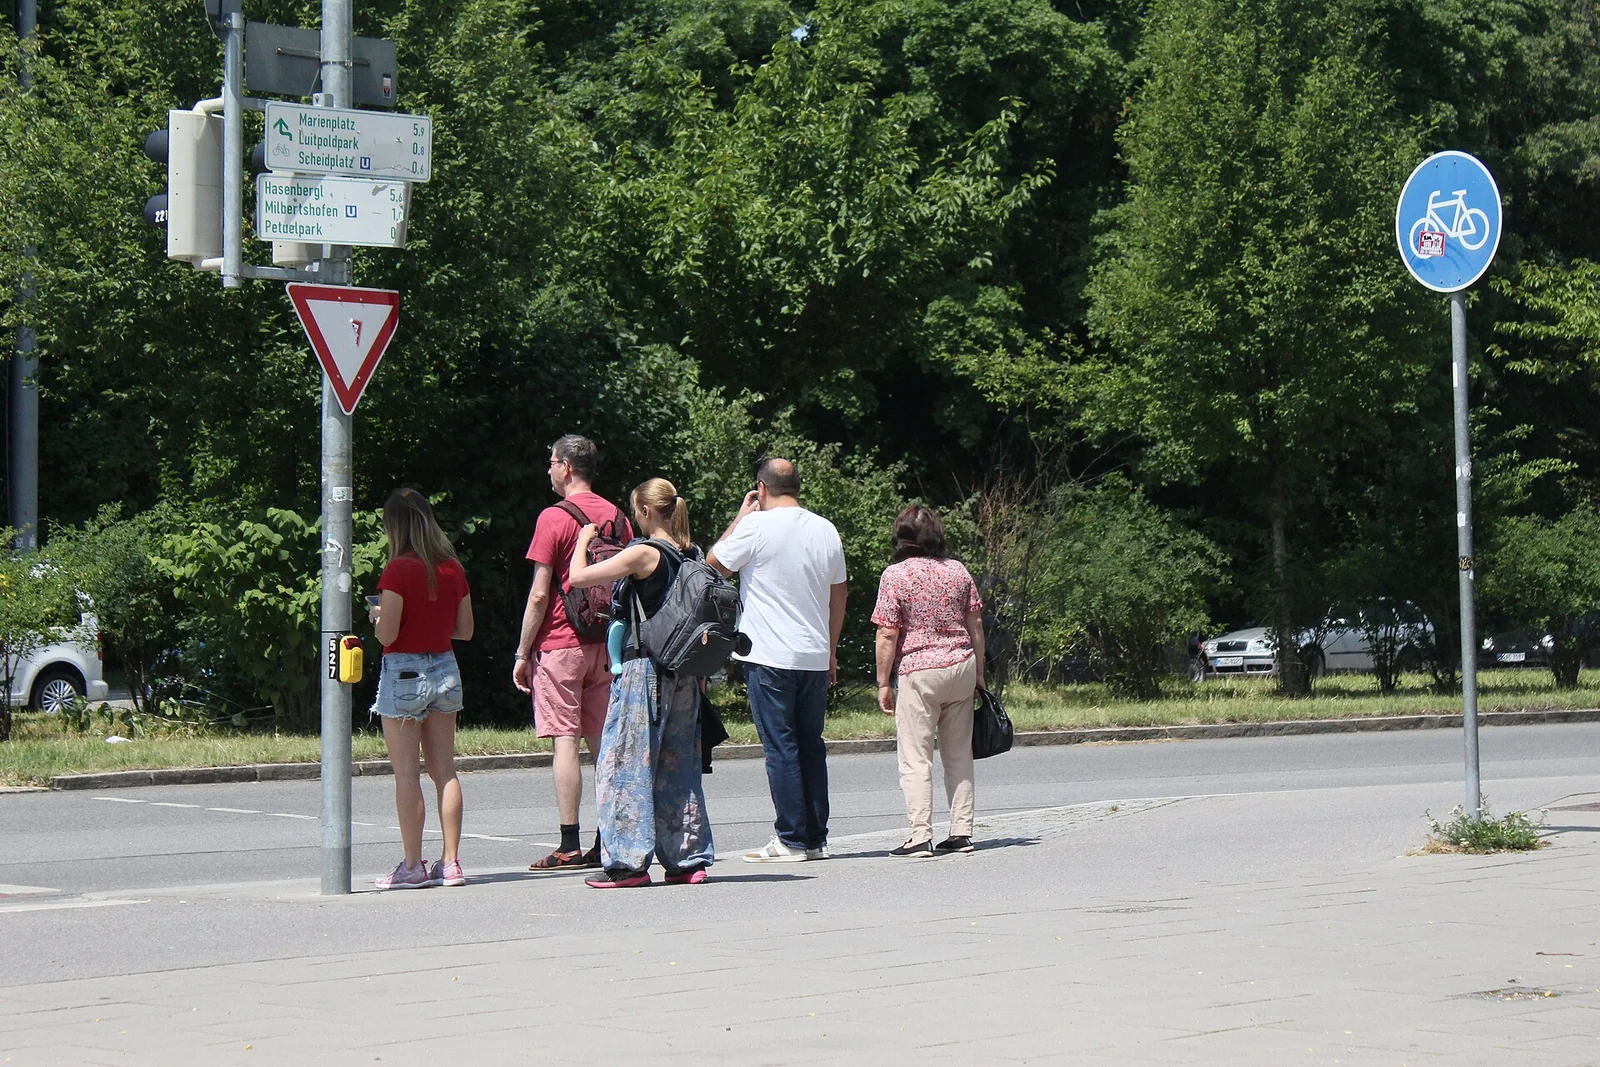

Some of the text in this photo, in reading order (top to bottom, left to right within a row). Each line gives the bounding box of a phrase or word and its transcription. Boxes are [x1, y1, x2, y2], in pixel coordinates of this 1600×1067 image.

[299, 112, 355, 131] Marienplatz
[298, 129, 359, 151] Luitpoldpark
[298, 151, 354, 170] Scheidplatz
[361, 158, 369, 169] U
[264, 181, 324, 200] Hasenbergl
[265, 200, 338, 217] Milbertshofen
[346, 206, 356, 217] U
[265, 219, 323, 238] Petuelpark
